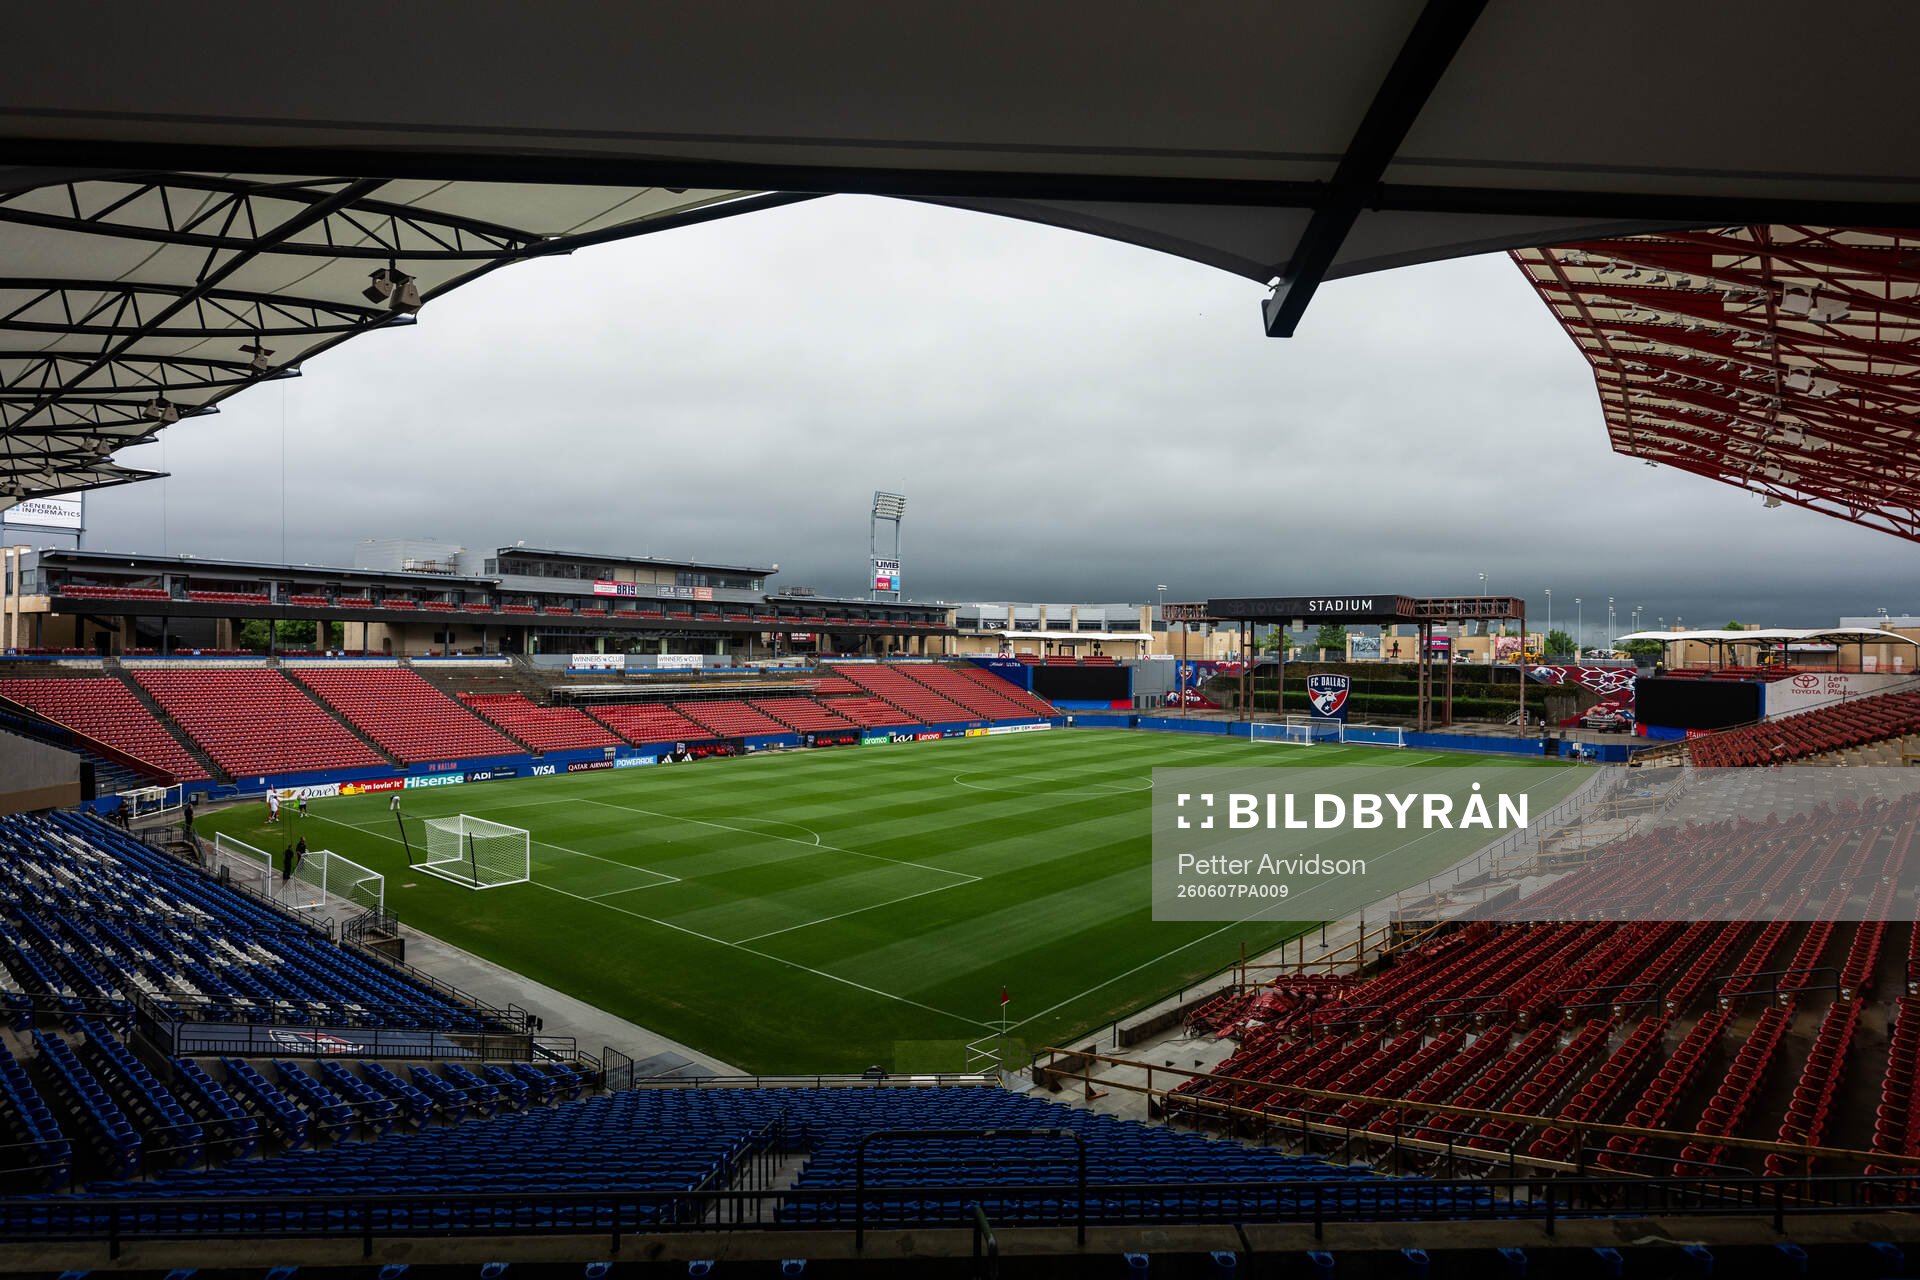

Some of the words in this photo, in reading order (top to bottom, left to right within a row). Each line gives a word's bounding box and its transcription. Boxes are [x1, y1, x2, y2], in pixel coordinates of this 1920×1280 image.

[22, 502, 63, 510] GENERAL
[22, 507, 81, 517] INFORMATICS
[876, 561, 899, 569] UMB
[616, 584, 636, 596] BR19
[1308, 599, 1373, 612] STADIUM
[1310, 677, 1319, 687] FC
[1321, 676, 1346, 688] DALLAS
[918, 733, 939, 741] Lenovo
[589, 761, 614, 769] AIRWAYS
[531, 765, 555, 776] VISA
[473, 772, 491, 780] ADI
[404, 776, 464, 789] Hisense
